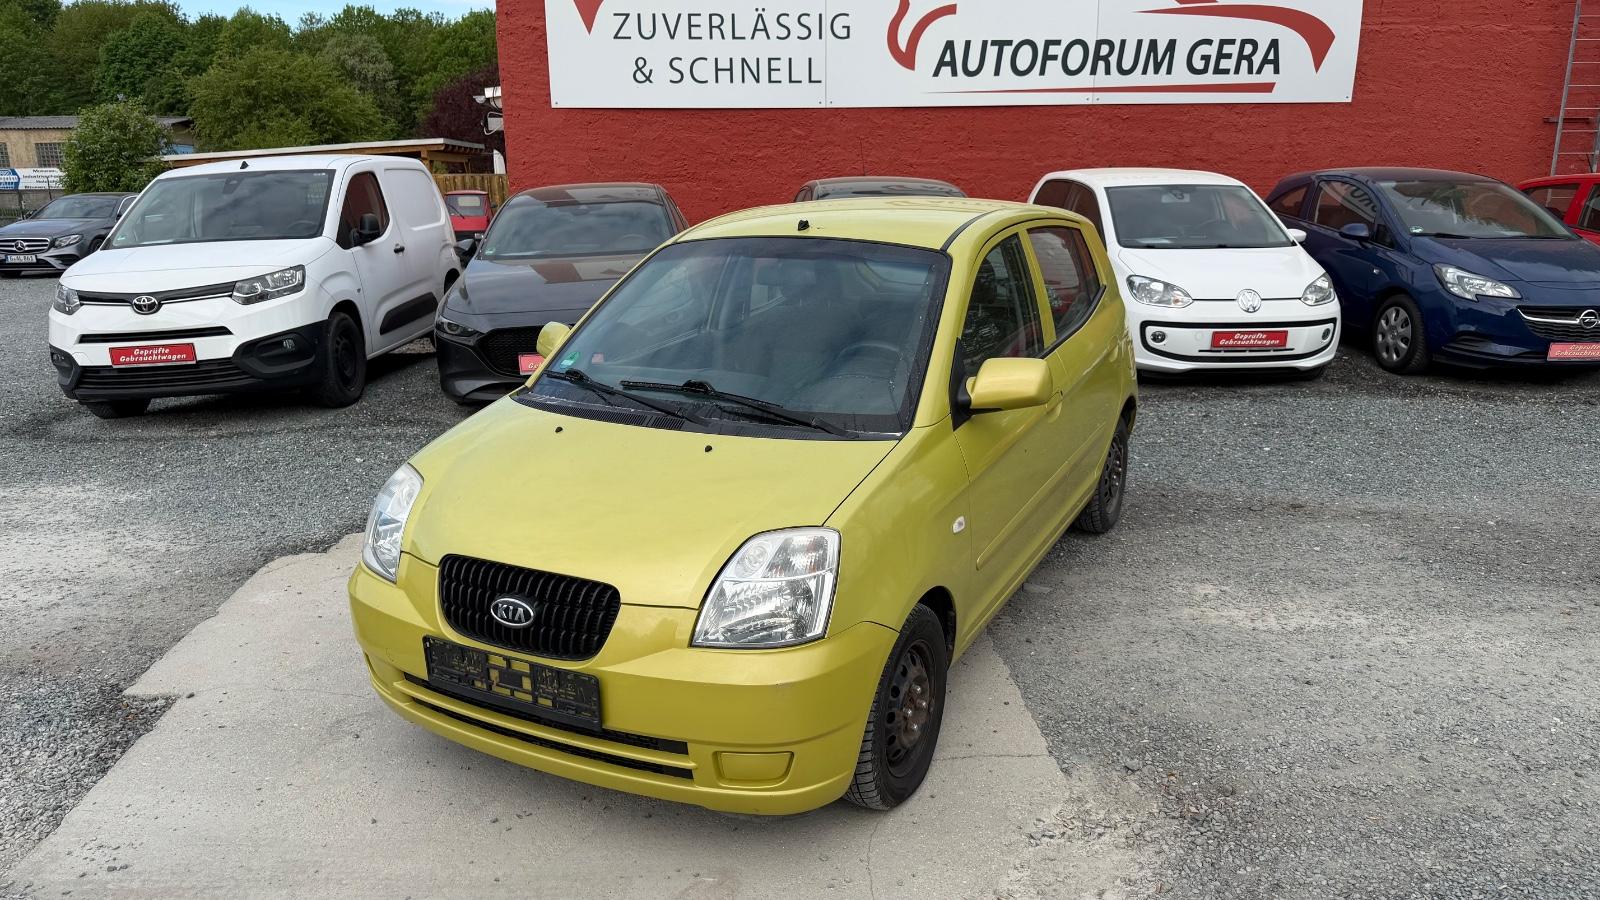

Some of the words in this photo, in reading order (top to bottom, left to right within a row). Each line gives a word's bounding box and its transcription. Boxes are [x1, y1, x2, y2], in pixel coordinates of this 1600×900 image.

[612, 8, 851, 41] ZUVERLÄSSIG
[932, 38, 1176, 78] AUTOFORUM
[1185, 38, 1281, 75] GERA
[632, 56, 654, 84] &
[668, 56, 822, 84] SCHNELL
[1234, 333, 1267, 341] Geprüfte
[120, 353, 186, 362] Gebrauchtwagen
[134, 347, 170, 355] Geprüfte
[497, 603, 526, 622] KIA
